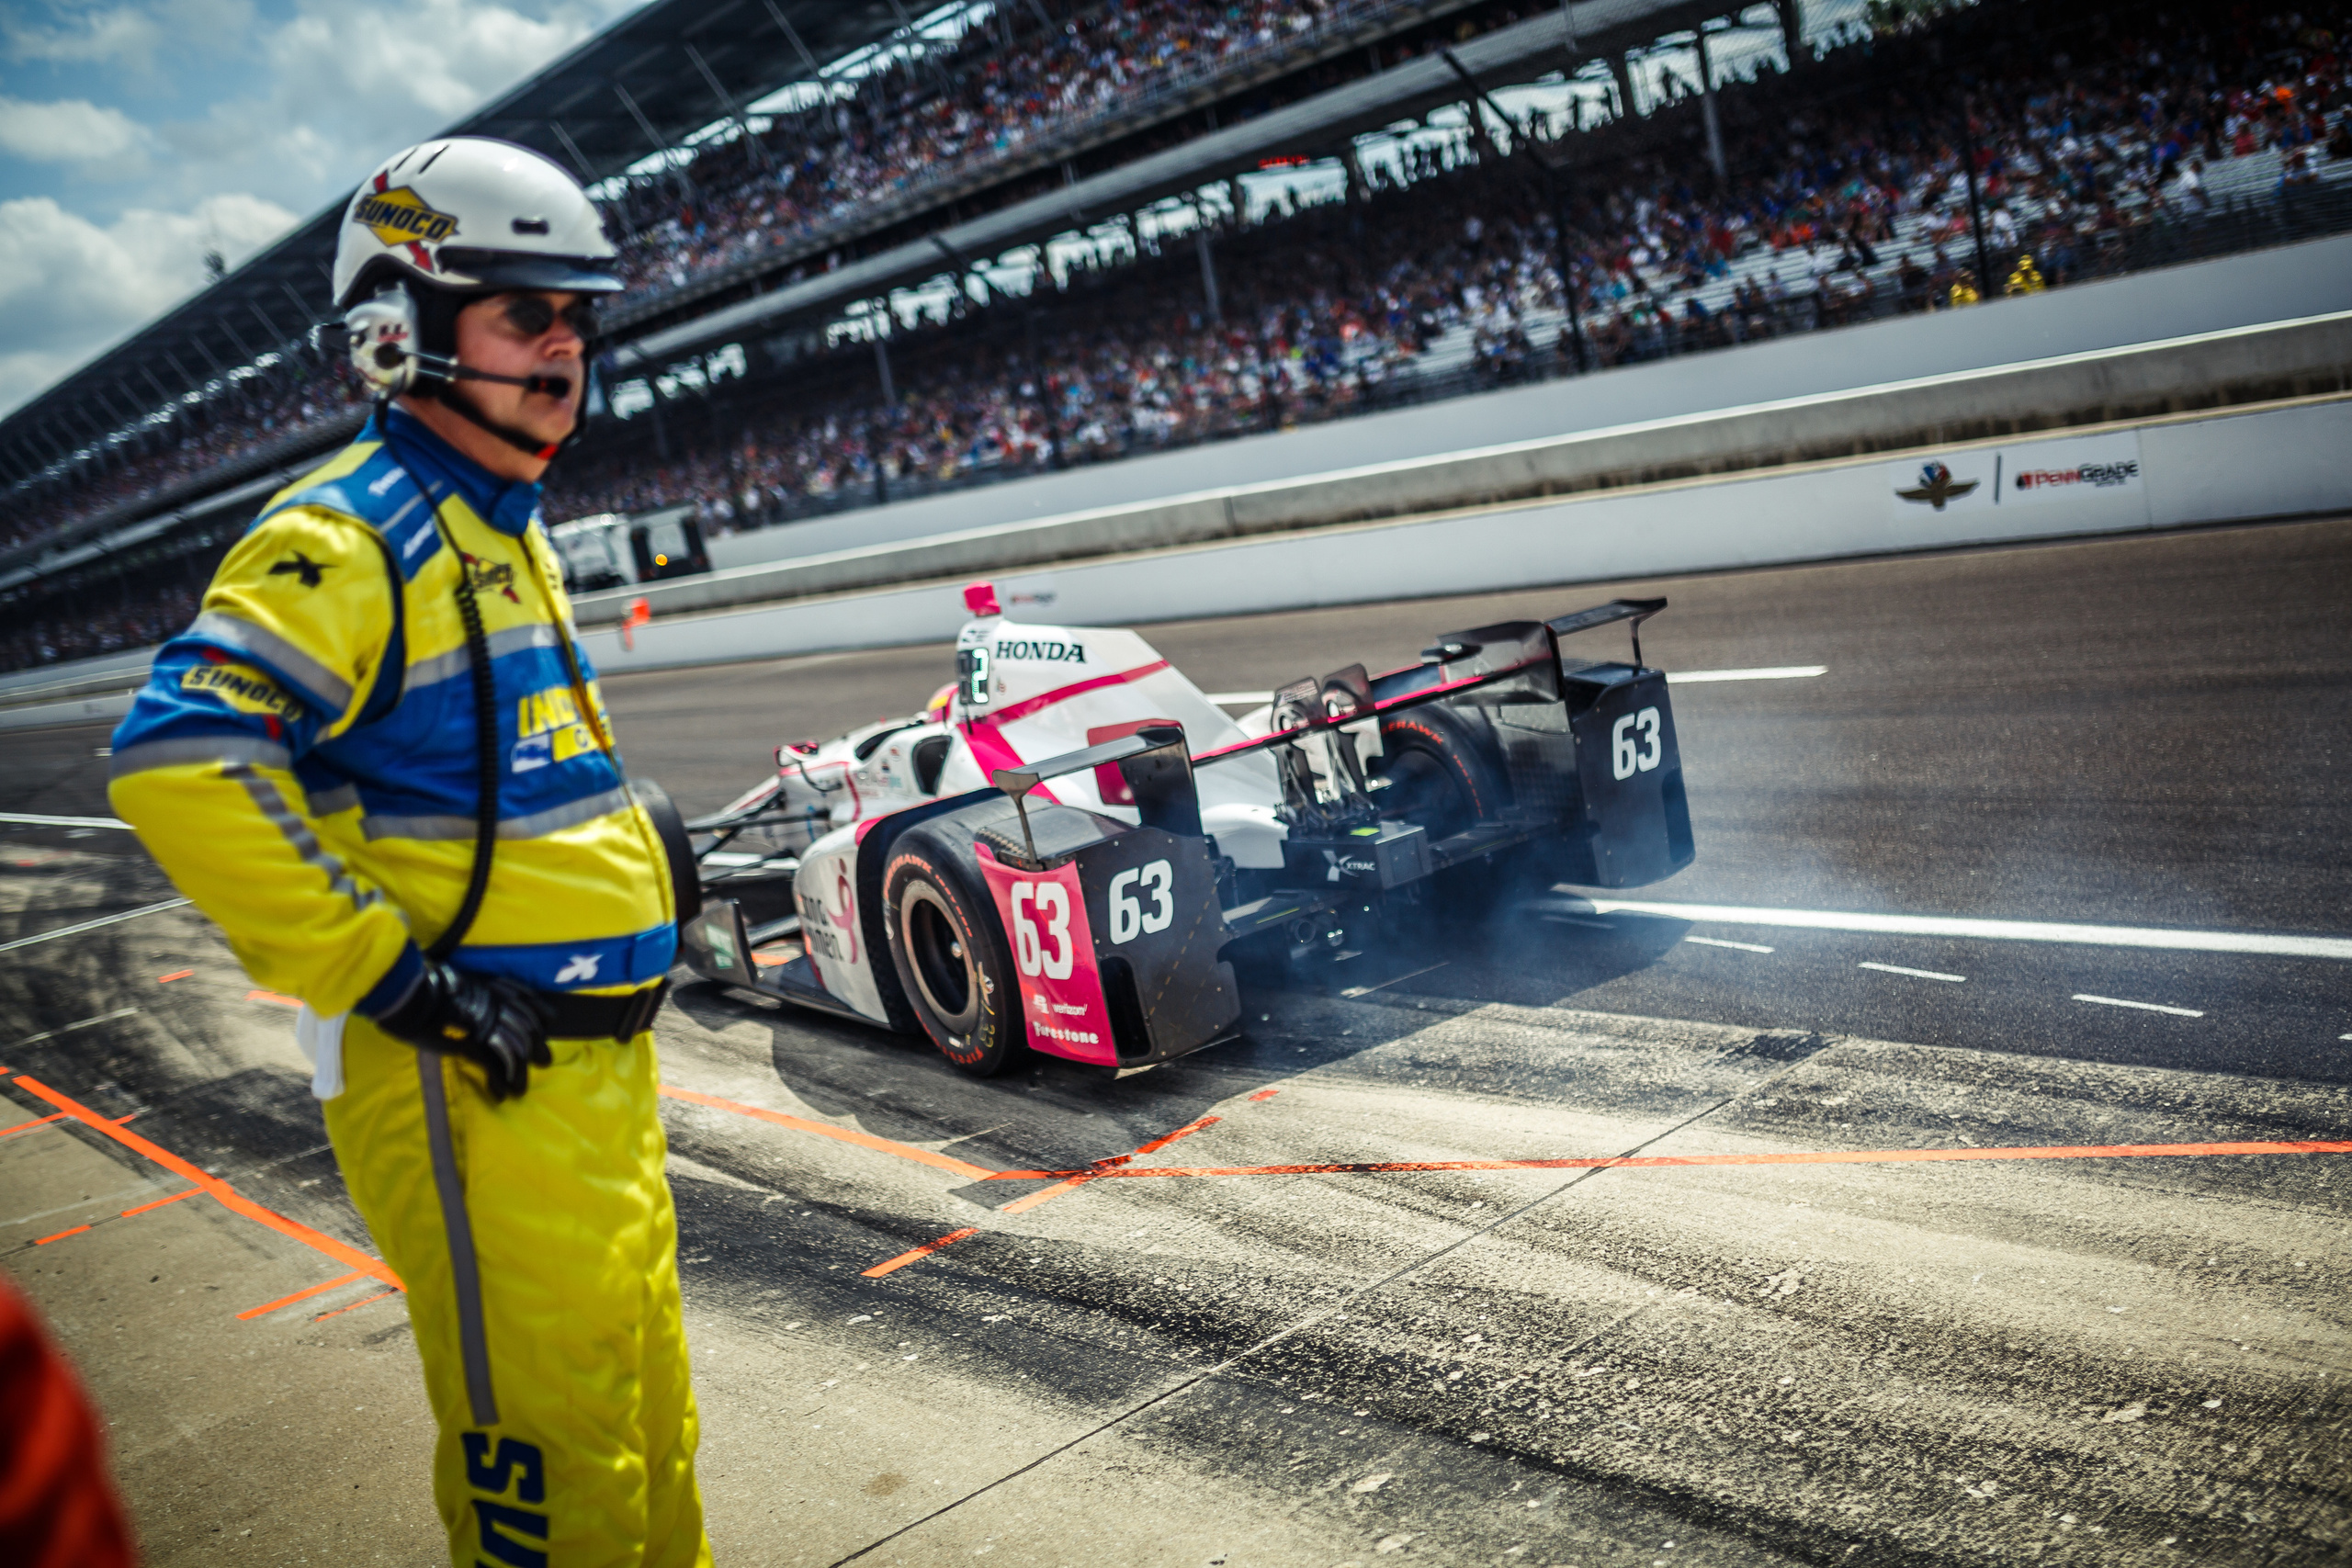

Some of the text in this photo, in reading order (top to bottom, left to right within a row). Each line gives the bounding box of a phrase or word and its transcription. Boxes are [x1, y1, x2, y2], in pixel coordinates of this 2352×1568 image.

[355, 198, 450, 240] SUNOCO
[972, 649, 989, 703] 2
[996, 641, 1086, 664] HONDA
[189, 667, 301, 720] SUNOCO
[1612, 706, 1661, 781] 63
[1109, 859, 1174, 945] 63
[1012, 882, 1073, 980] 63
